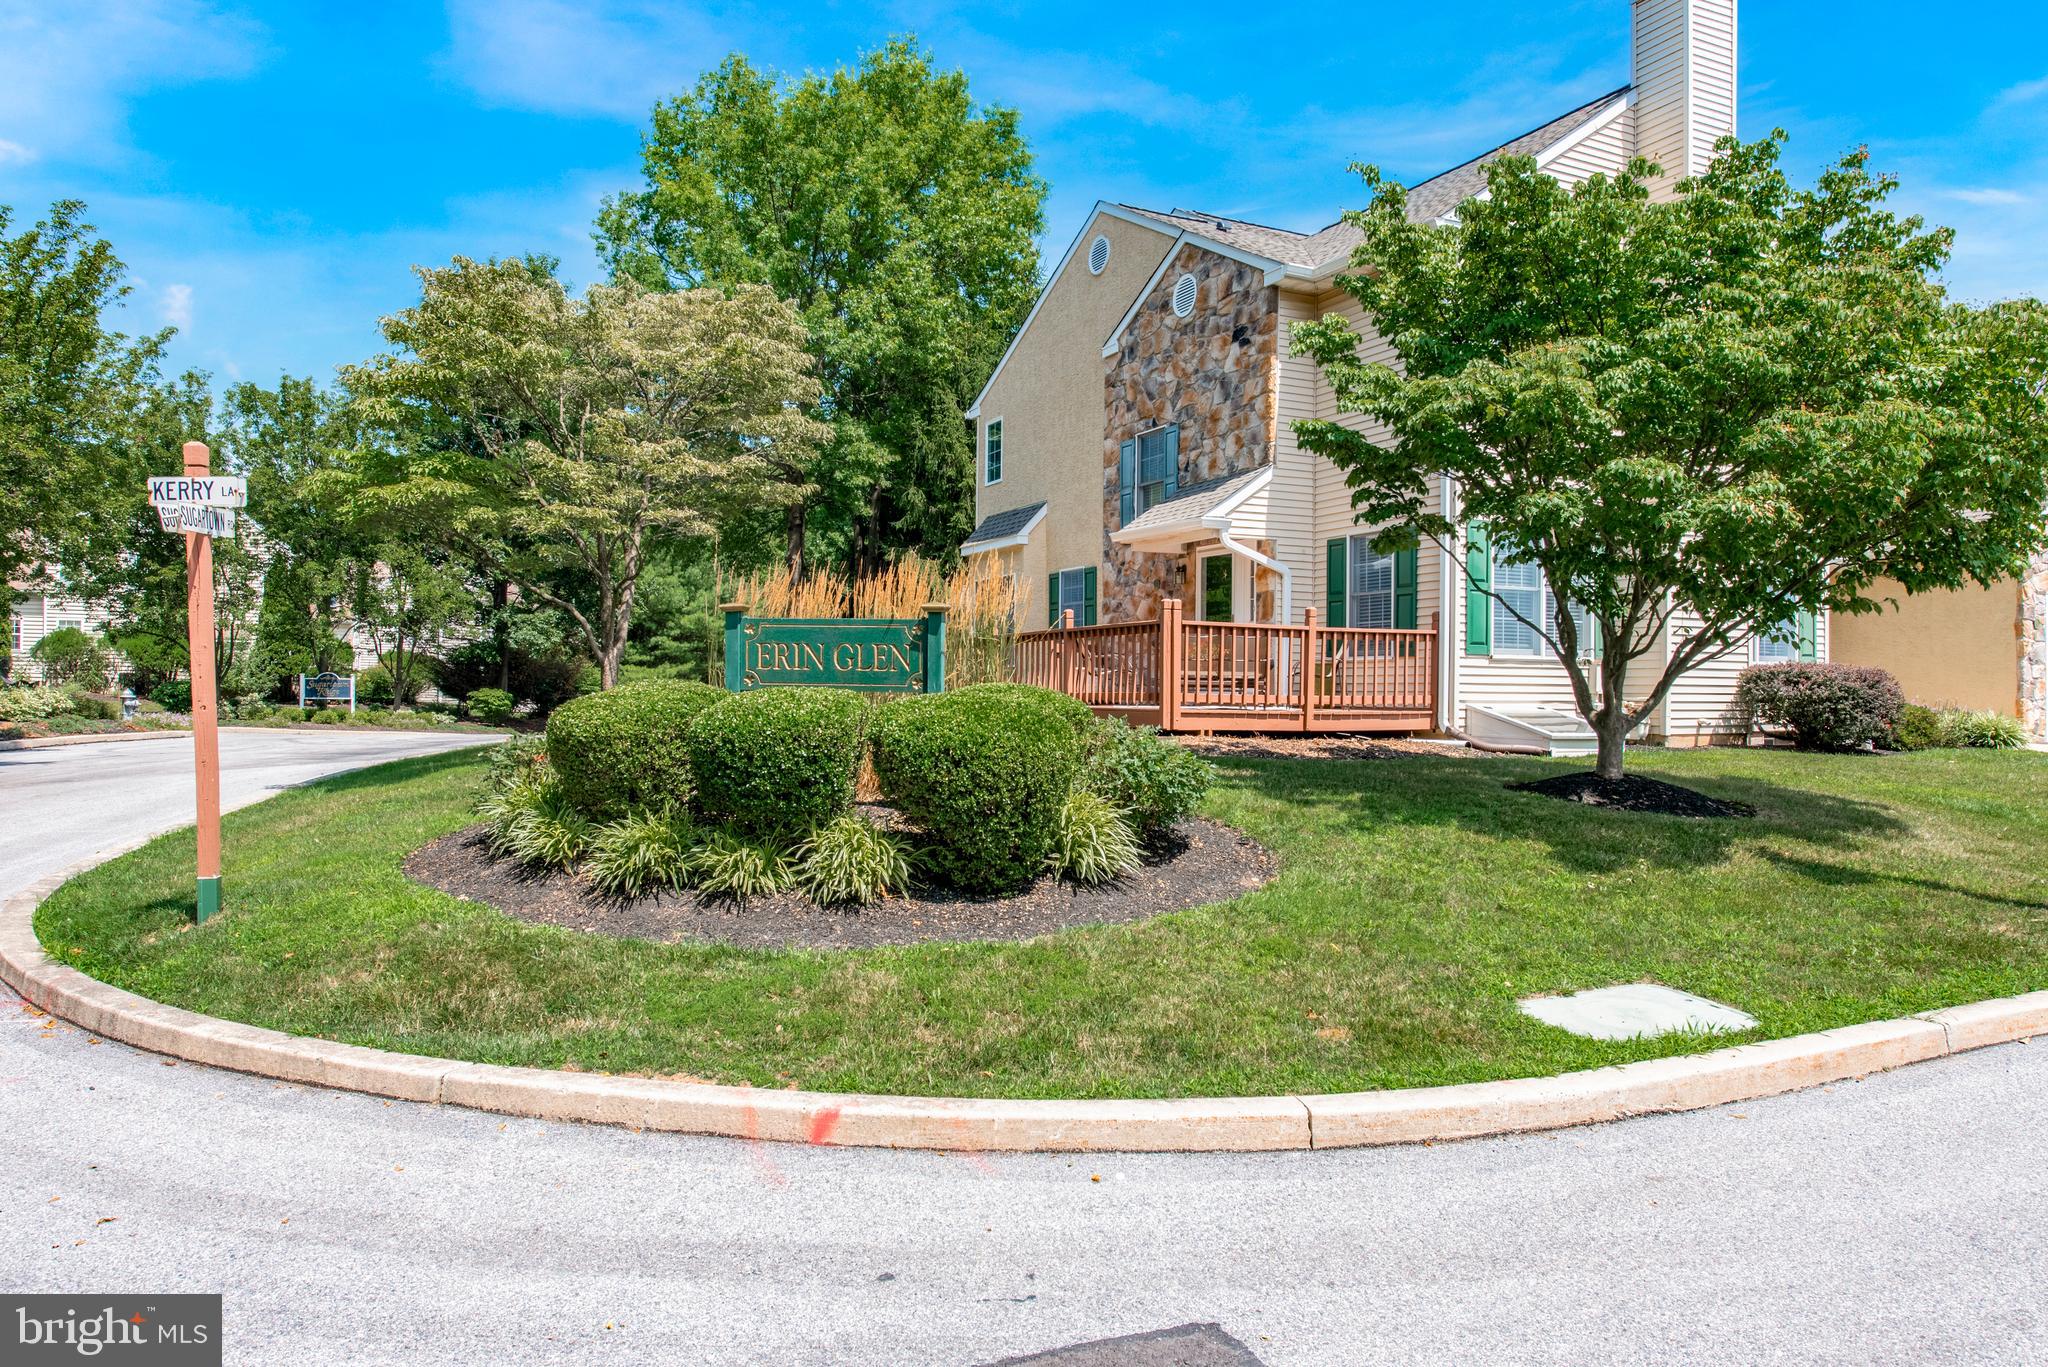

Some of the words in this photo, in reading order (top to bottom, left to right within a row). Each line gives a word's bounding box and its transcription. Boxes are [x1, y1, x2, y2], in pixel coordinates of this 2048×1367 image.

[153, 480, 214, 501] KERRY
[221, 486, 235, 497] LA
[181, 505, 225, 530] SUGARTOWN
[755, 642, 824, 671] ERIN
[833, 643, 911, 672] GLEN
